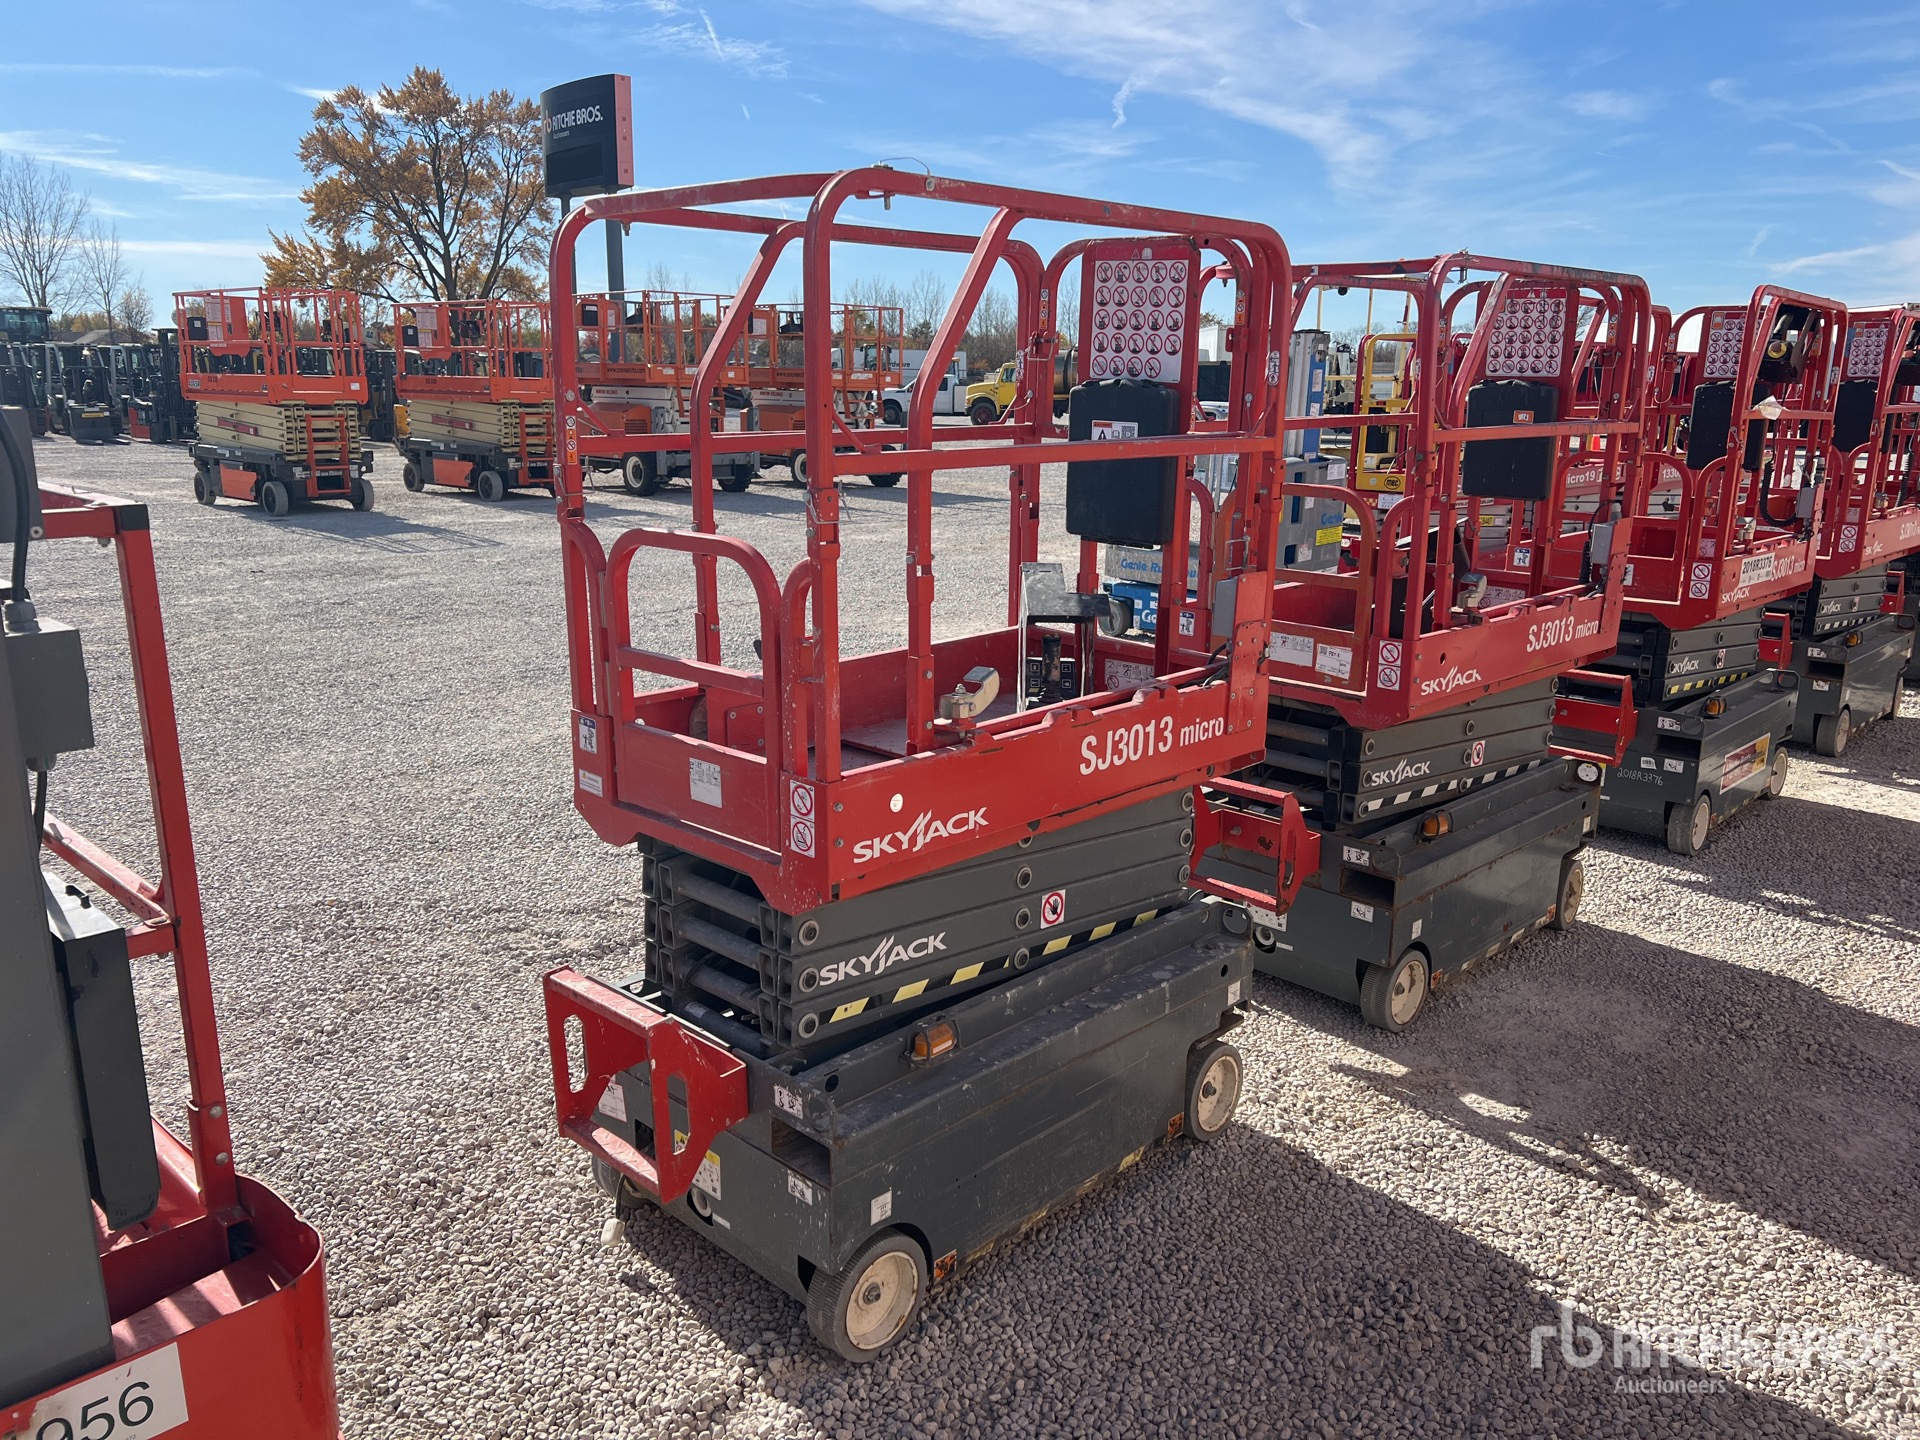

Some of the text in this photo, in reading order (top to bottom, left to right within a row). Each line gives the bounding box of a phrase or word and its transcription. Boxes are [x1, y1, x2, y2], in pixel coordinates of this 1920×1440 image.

[552, 110, 576, 131] RITCHIE
[1120, 558, 1148, 572] Genie
[1526, 616, 1600, 652] SJ3013 micro
[1420, 665, 1482, 696] SKYJACK
[1079, 715, 1225, 776] SJ3013 micro
[1371, 758, 1431, 787] SKYJACK
[852, 806, 989, 864] SKYJACK
[819, 931, 948, 986] SKYJACK
